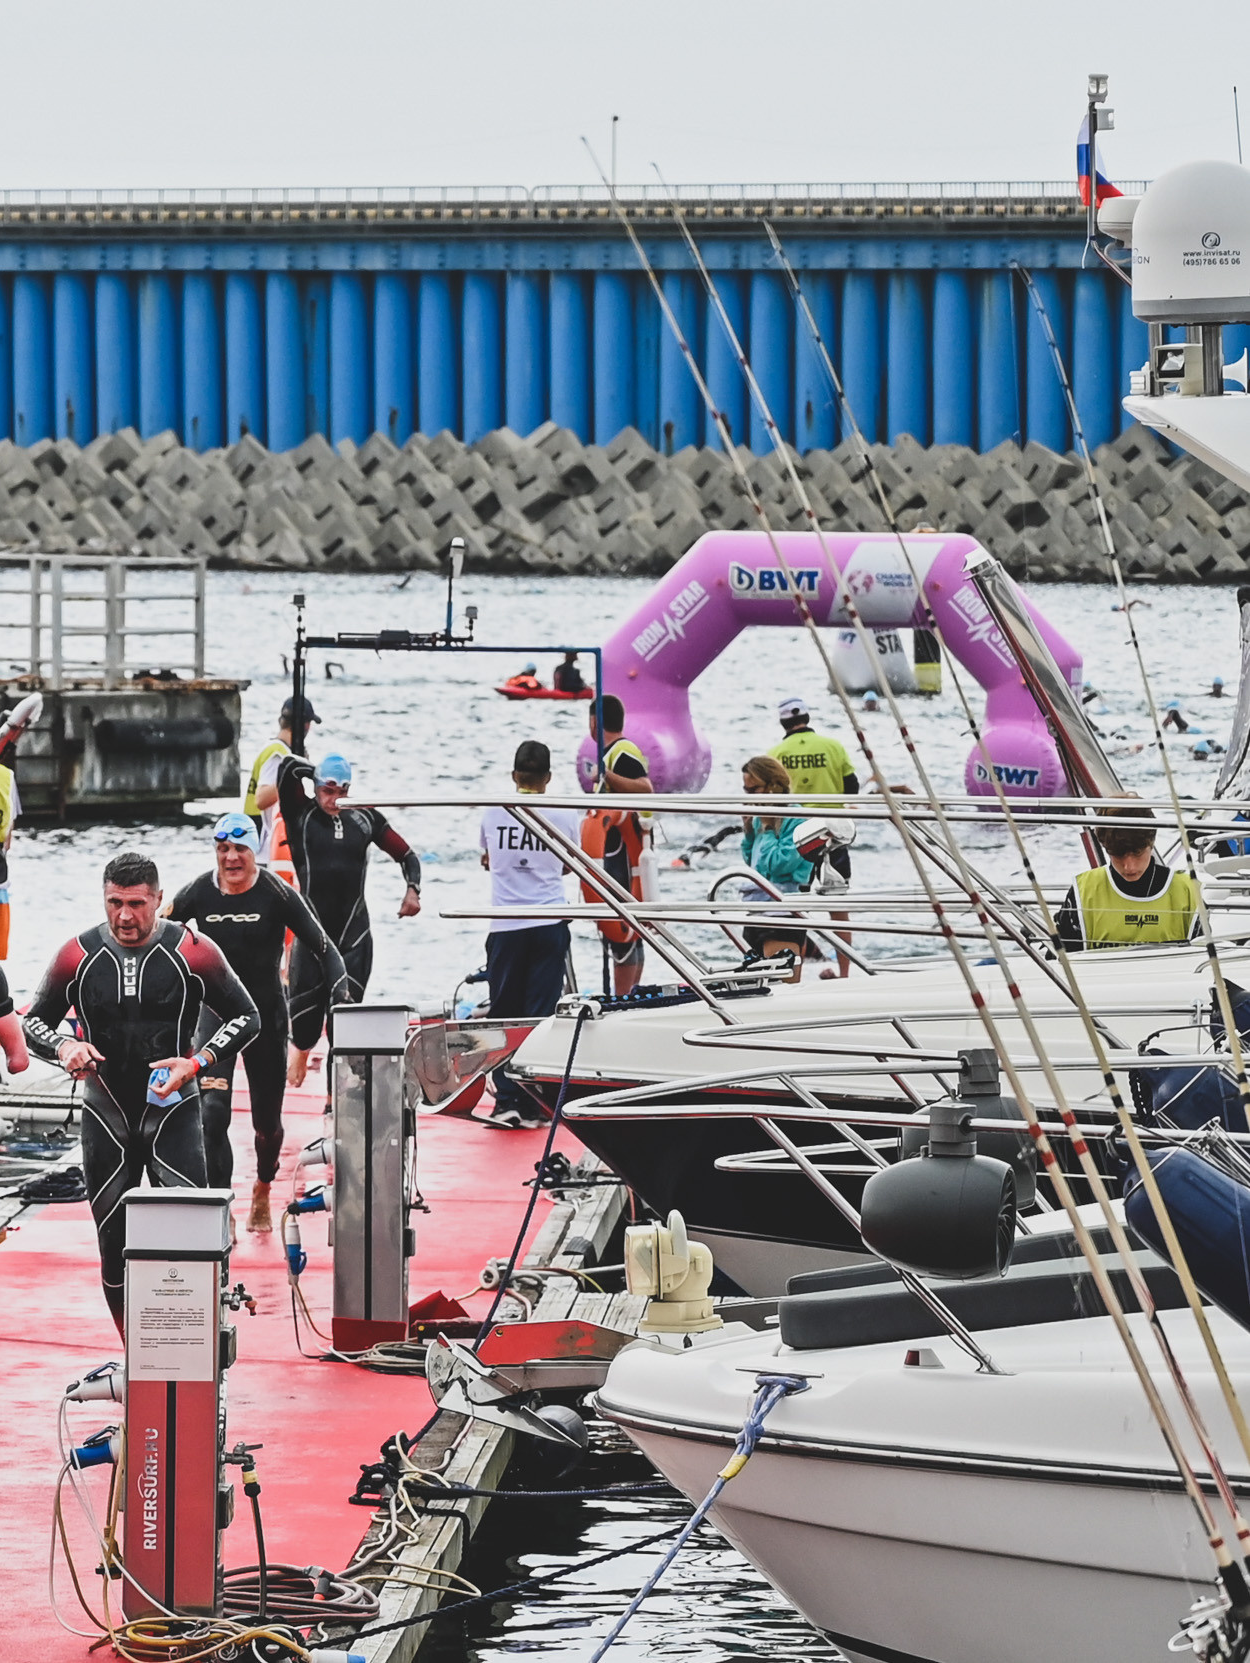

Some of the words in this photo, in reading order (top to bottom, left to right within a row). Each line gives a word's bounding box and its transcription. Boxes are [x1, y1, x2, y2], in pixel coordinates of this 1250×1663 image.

[1183, 249, 1241, 257] www.invisat.ru
[1183, 257, 1217, 266] (495)786
[1219, 257, 1229, 265] 65
[1231, 257, 1241, 265] 06
[759, 570, 819, 591] BWT
[953, 585, 990, 623] IRON
[631, 620, 668, 657] IRON
[669, 580, 706, 617] STAR
[781, 752, 827, 769] REFEREE
[992, 765, 1039, 787] BWT
[1125, 914, 1138, 922] IRON
[1144, 914, 1159, 922] STAR
[123, 957, 137, 996] HUUB
